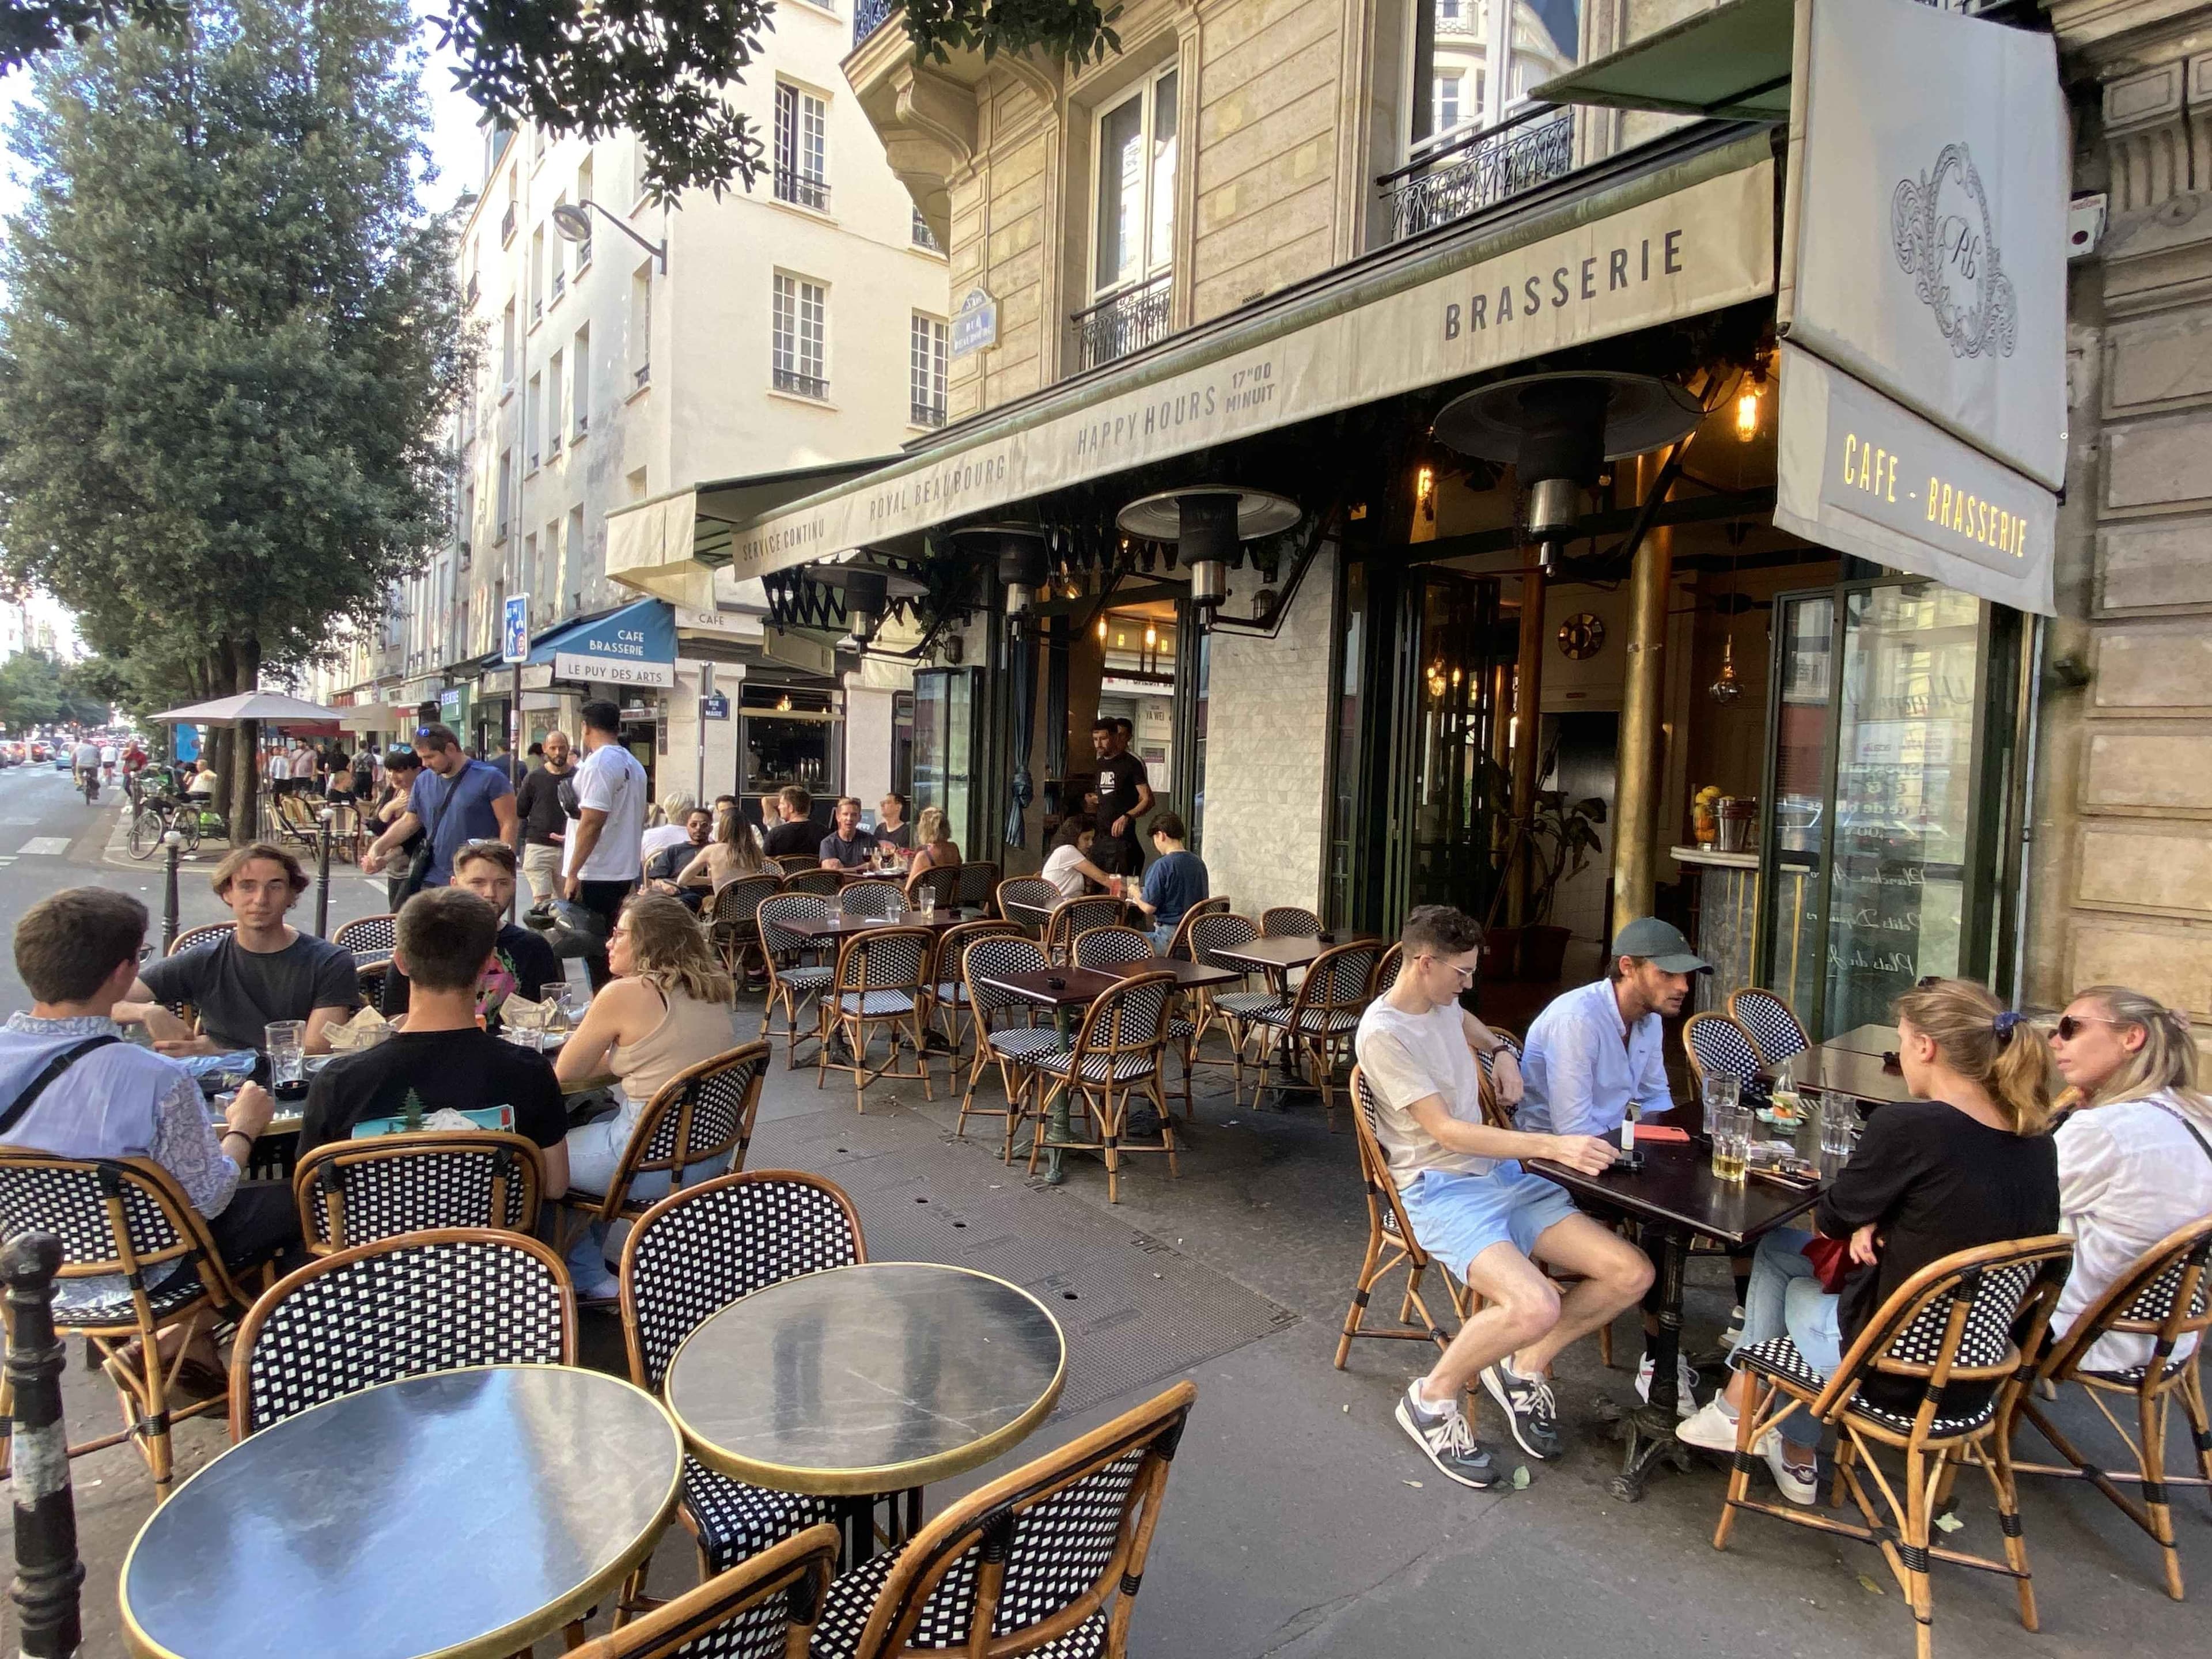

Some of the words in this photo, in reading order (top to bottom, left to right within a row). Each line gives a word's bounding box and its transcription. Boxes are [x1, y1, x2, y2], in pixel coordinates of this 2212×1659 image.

[1445, 229, 1683, 342] BRASSERIE
[1225, 383, 1275, 414] MINUIT
[1077, 411, 1137, 456] HAPPY
[1144, 385, 1215, 435] HOURS
[870, 490, 907, 521] ROYAL
[915, 454, 1005, 506] BEAUBOURG
[1844, 433, 1899, 503] CAFE
[1927, 476, 2028, 558] BRASSERIE
[742, 533, 781, 562] SERVICE
[783, 518, 824, 549] CONTINU
[617, 629, 645, 643] CAFE
[699, 613, 724, 626] CAFE
[589, 639, 644, 656] BRASSERIE
[568, 663, 581, 675] LE
[585, 666, 607, 678] PUY
[611, 669, 632, 680] DES
[636, 671, 662, 683] ARTS
